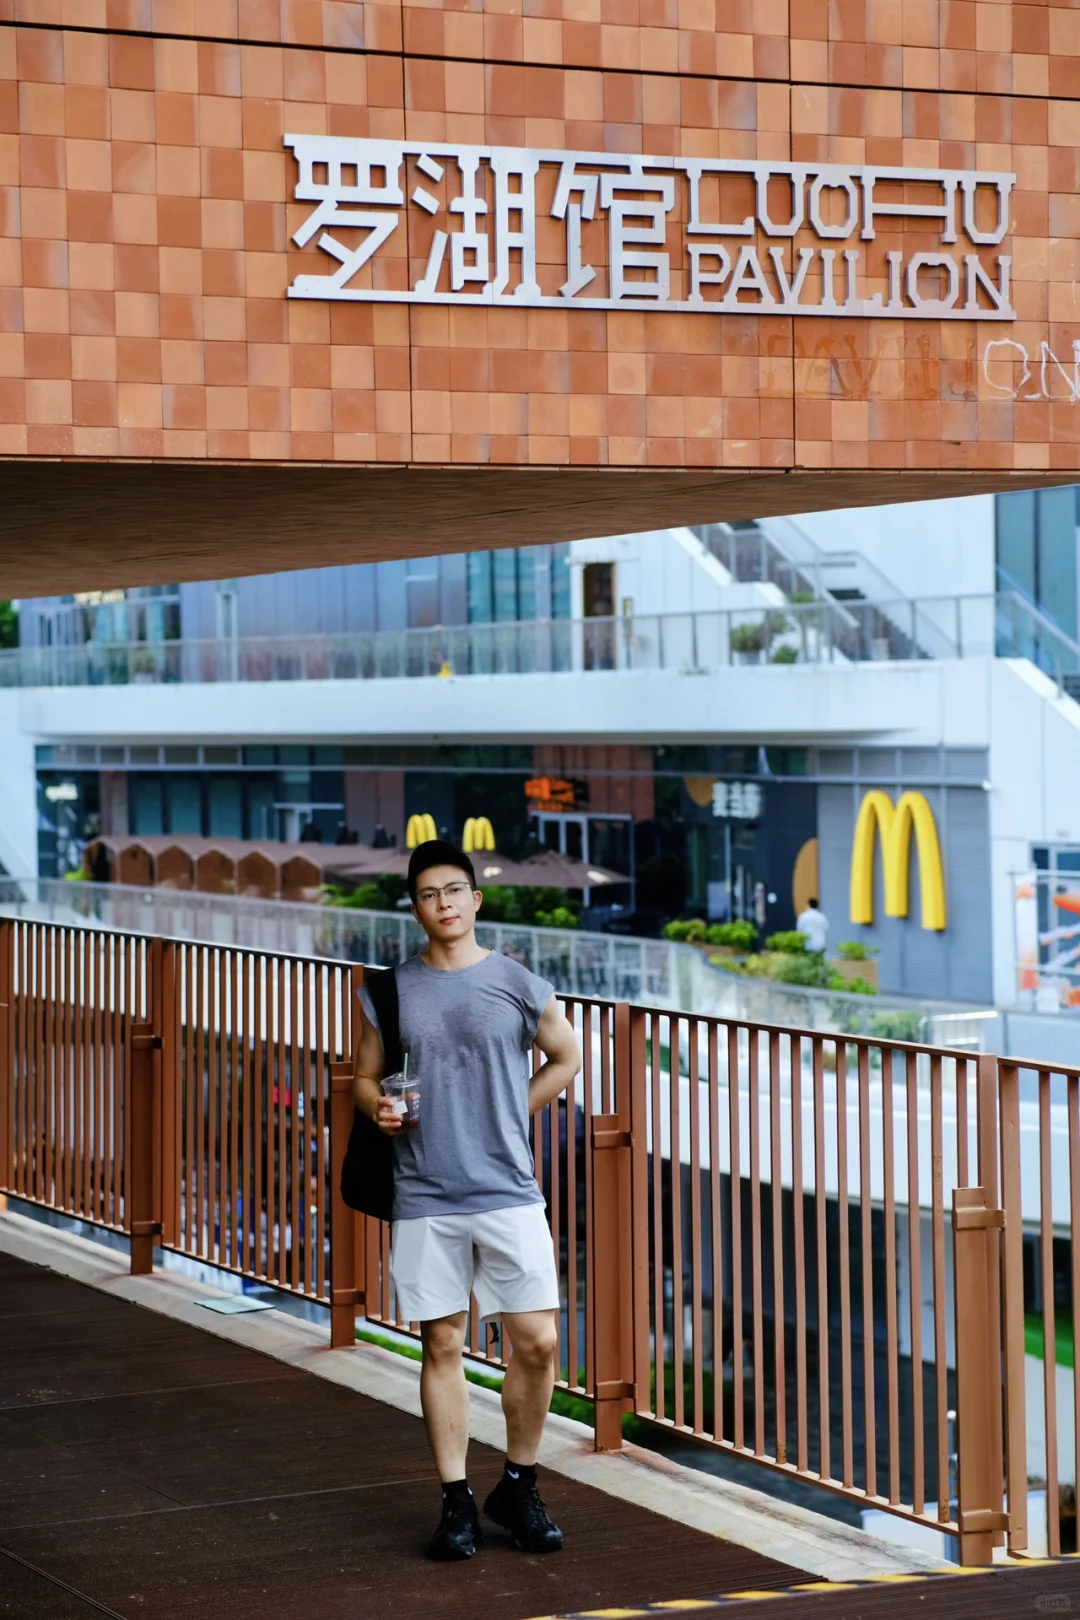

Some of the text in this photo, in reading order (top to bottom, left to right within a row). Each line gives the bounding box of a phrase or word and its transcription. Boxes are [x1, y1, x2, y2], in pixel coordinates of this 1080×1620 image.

[283, 134, 675, 310] 罗湖馆
[685, 158, 1016, 246] LUOHU
[685, 242, 1014, 317] PAVILION
